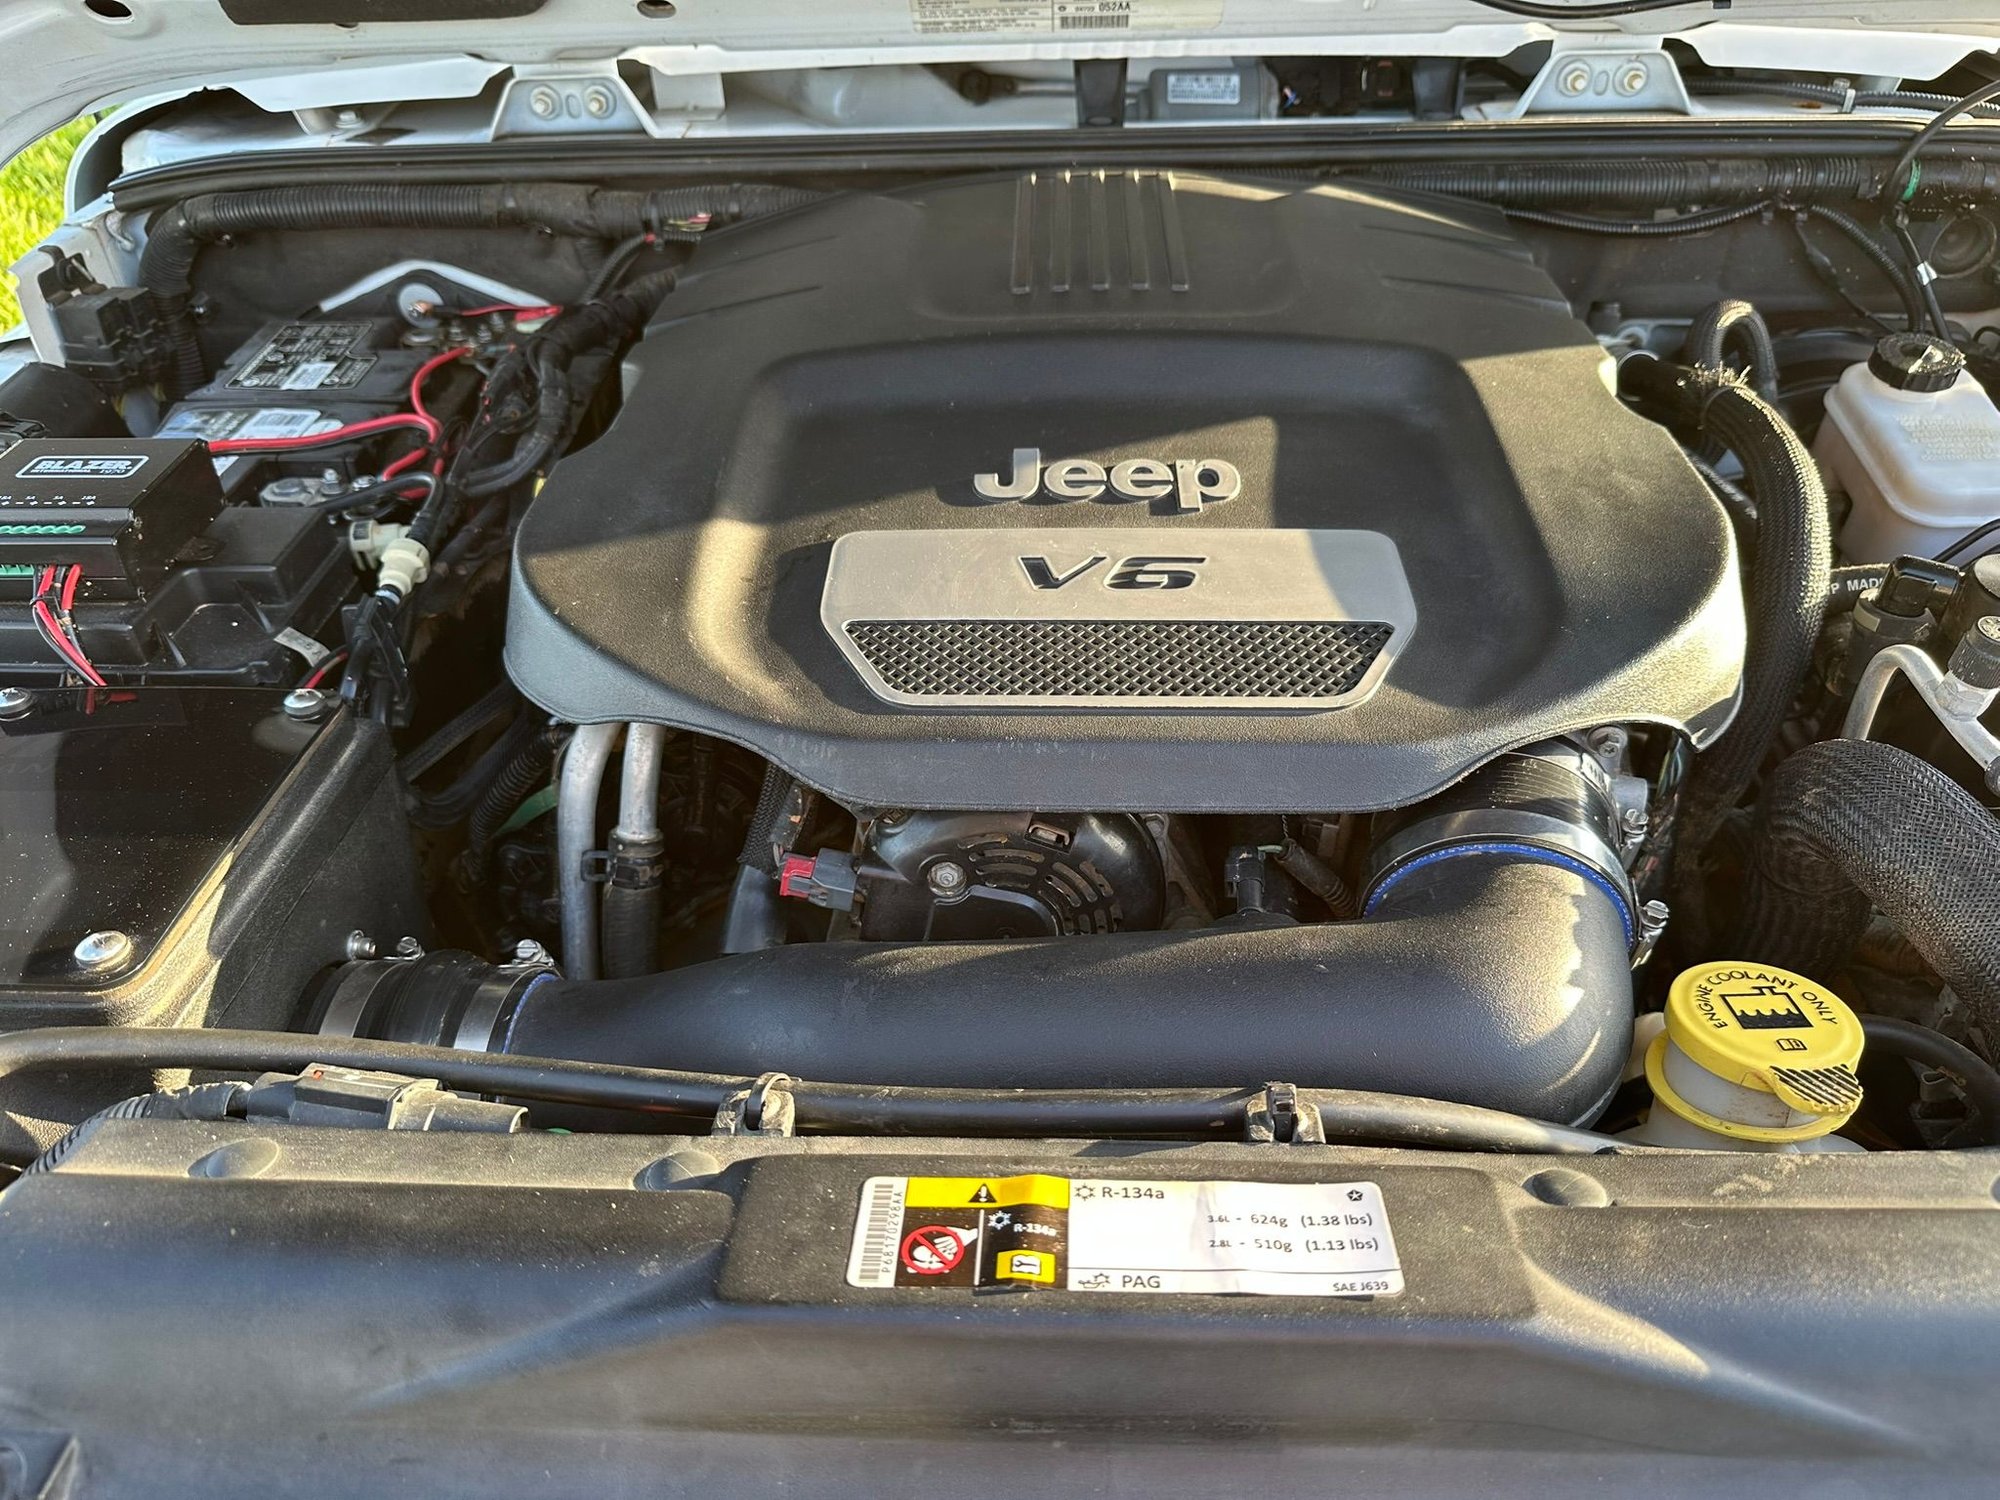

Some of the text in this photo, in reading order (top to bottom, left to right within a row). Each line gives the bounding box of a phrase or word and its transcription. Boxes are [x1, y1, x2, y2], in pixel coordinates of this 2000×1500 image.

[34, 460, 130, 470] BLAZER
[973, 447, 1242, 513] Jeep
[1017, 556, 1207, 590] V6
[1846, 577, 1884, 592] MAD
[1695, 970, 1839, 1029] ENGINE COOLANT ONLY
[1102, 1186, 1165, 1200] R-134a
[1207, 1215, 1230, 1223] 3.6L
[1250, 1214, 1288, 1228] 624g
[1300, 1214, 1340, 1228] (1.38
[1344, 1212, 1374, 1226] lbs)
[1013, 1222, 1058, 1238] R-134a
[1209, 1239, 1232, 1248] 2.8L
[1254, 1238, 1293, 1253] 510g
[1305, 1240, 1346, 1253] (1.13
[1350, 1237, 1380, 1251] lbs)
[1121, 1275, 1161, 1289] PAG
[1332, 1281, 1390, 1292] SAE J639
